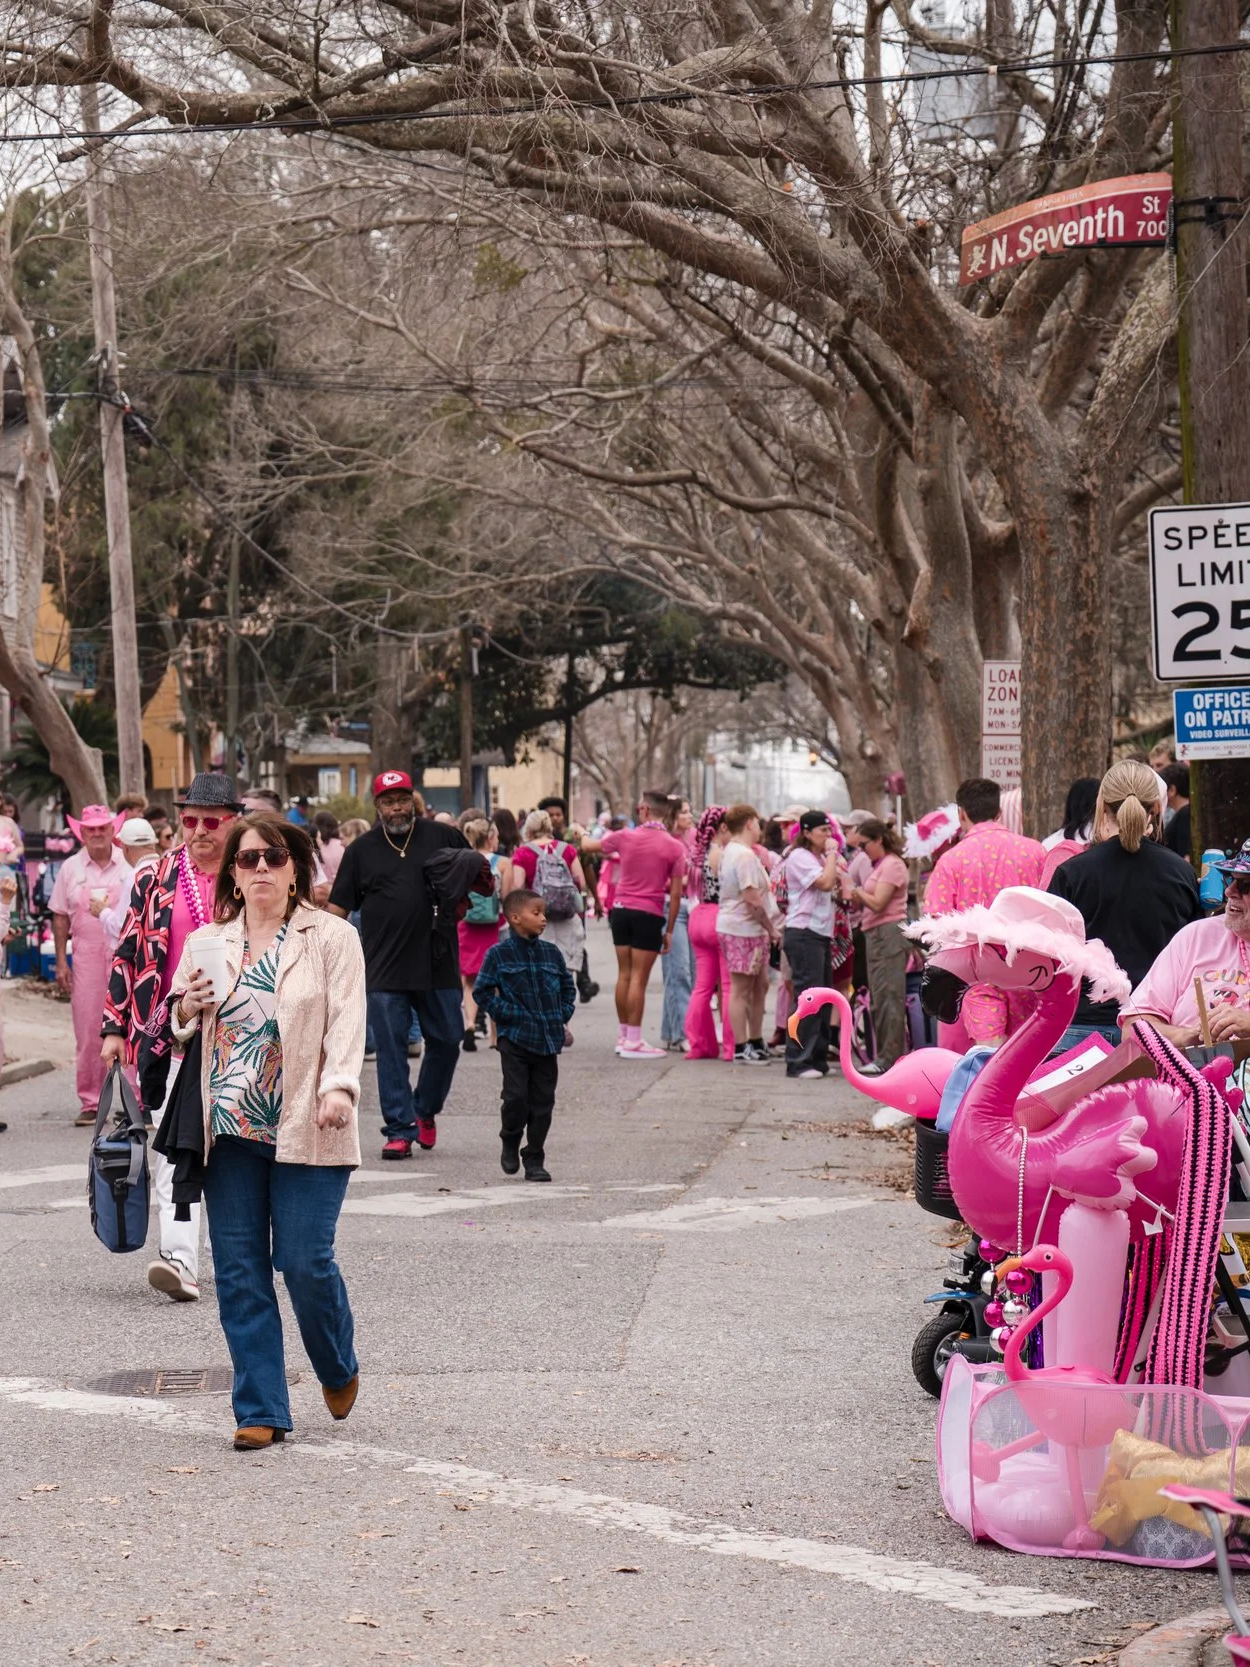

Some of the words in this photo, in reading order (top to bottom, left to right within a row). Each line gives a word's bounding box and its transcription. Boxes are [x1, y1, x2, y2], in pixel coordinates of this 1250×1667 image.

[1017, 204, 1124, 259] Seventh
[1142, 195, 1160, 214] St
[1136, 220, 1168, 237] 700
[1163, 522, 1250, 550] SPEE
[1177, 559, 1250, 587] LIMI
[989, 669, 1021, 682] LOA
[987, 686, 1018, 701] ZON
[1193, 691, 1250, 710] OFFICE
[1184, 711, 1207, 728] ON
[1212, 709, 1250, 726] PATR
[1190, 729, 1213, 739] VIDEO
[1214, 728, 1250, 738] SURVEILL
[984, 743, 1022, 752] COMMERC
[989, 757, 1021, 765] LICENS
[990, 770, 1001, 778] 30
